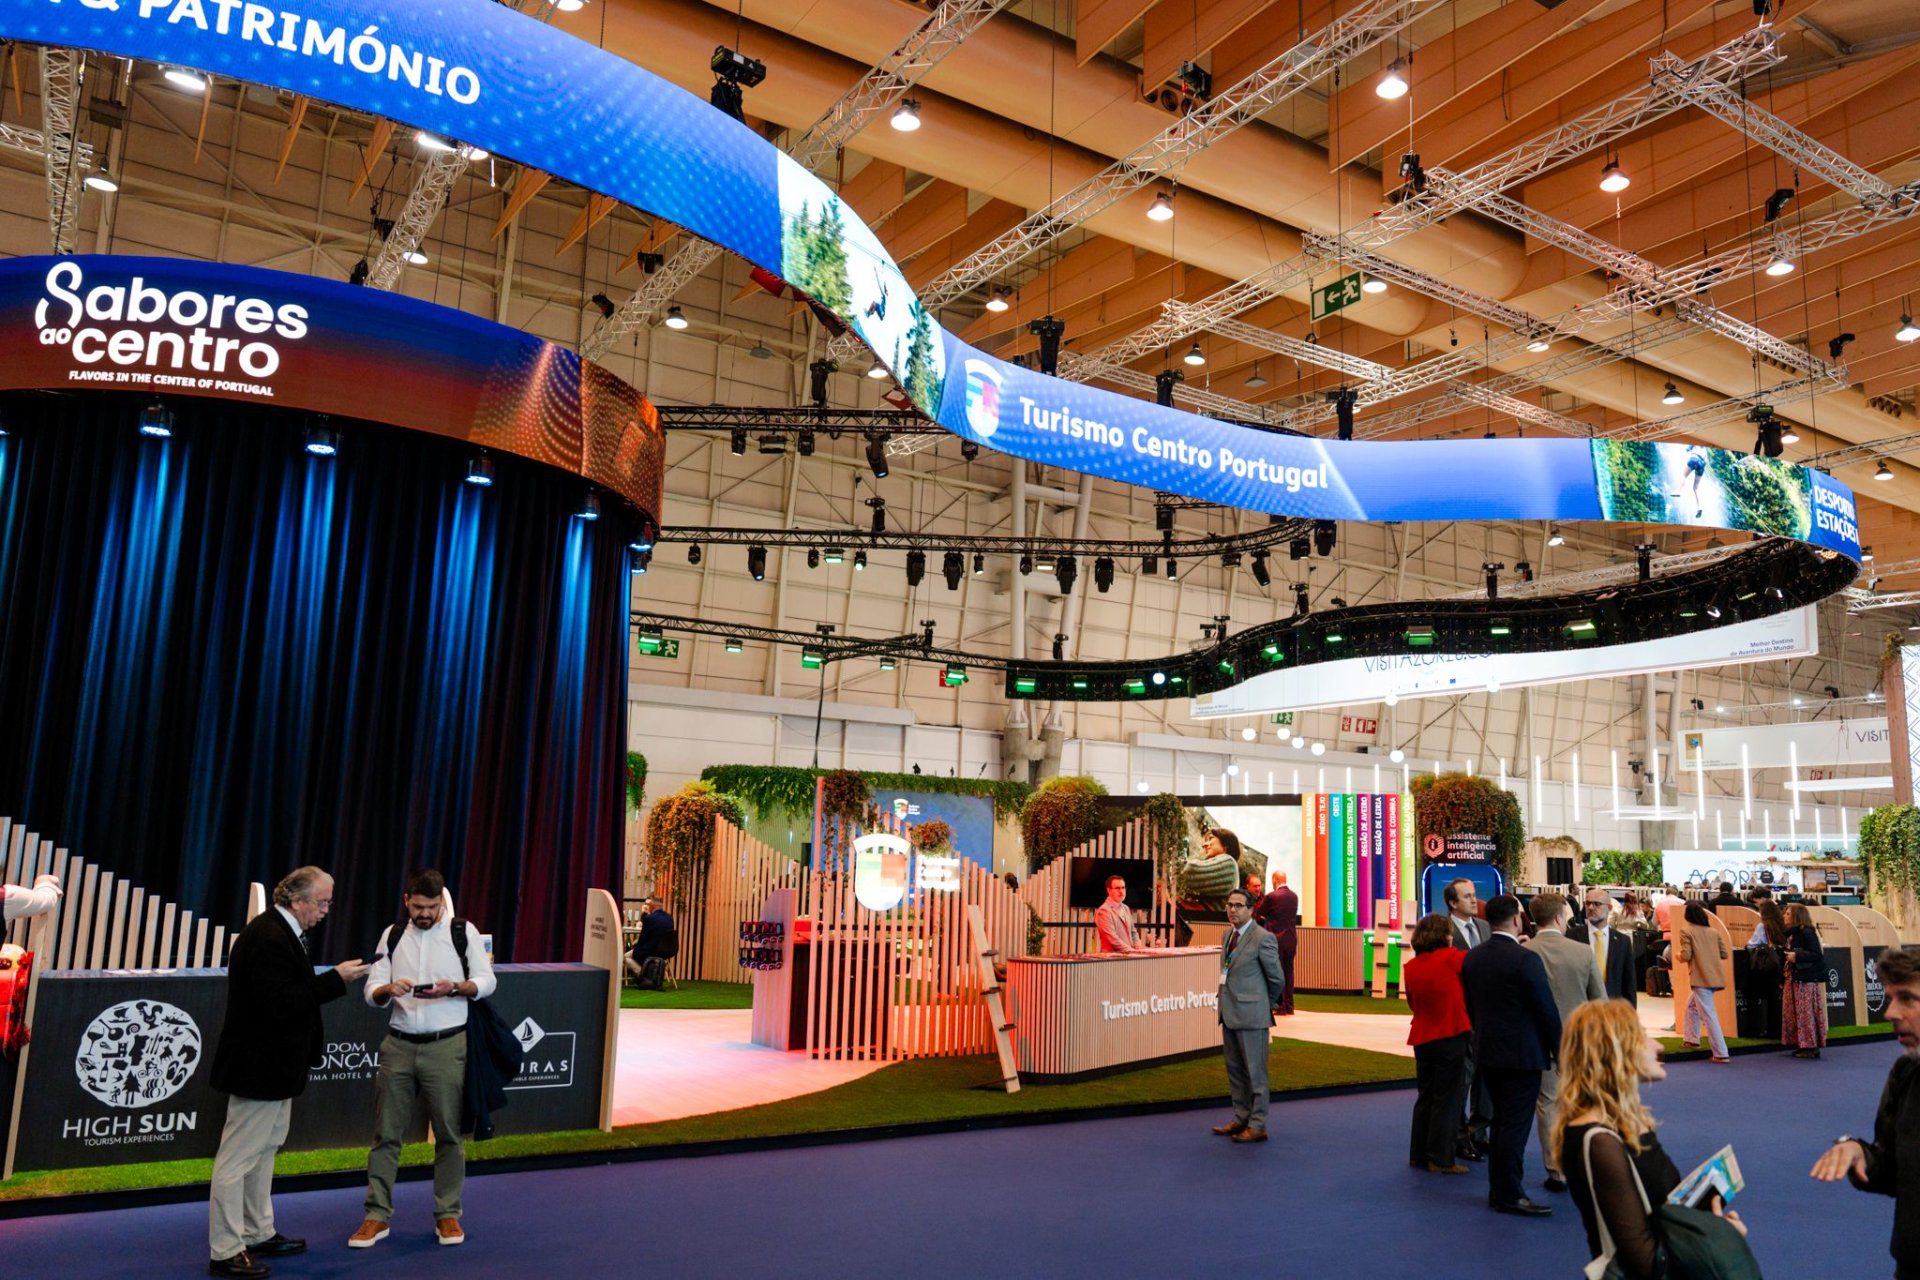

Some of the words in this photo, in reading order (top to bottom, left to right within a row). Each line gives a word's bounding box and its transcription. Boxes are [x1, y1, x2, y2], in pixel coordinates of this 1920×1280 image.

[139, 0, 481, 105] PATRIMÓNIO
[34, 261, 309, 340] Sabores
[39, 327, 72, 345] ao
[72, 327, 280, 378] centro
[69, 370, 115, 382] FLAVORS
[116, 373, 130, 383] IN
[131, 373, 152, 384] THE
[153, 374, 196, 388] CENTER
[198, 378, 214, 390] OF
[215, 380, 274, 397] PORTUGAL
[1019, 396, 1125, 448] Turismo
[1132, 428, 1213, 469] Centro
[1219, 448, 1328, 492] Portugal
[1347, 825, 1354, 834] DA
[1361, 822, 1368, 831] DE
[1375, 820, 1382, 829] DE
[1390, 828, 1397, 837] DE
[1360, 832, 1368, 857] REGIÃO
[1374, 830, 1382, 855] REGIÃO
[1447, 841, 1497, 851] inteligência
[1447, 851, 1485, 860] artificial
[1346, 887, 1354, 913] REGIÃO
[1388, 894, 1397, 920] REGIÃO
[1102, 997, 1148, 1020] Turismo
[1150, 993, 1185, 1013] Centro
[1187, 990, 1219, 1010] Portug
[326, 1042, 366, 1053] DOM
[310, 1052, 381, 1071] ONÇAL
[331, 1071, 361, 1080] HOTEL
[365, 1071, 372, 1079] &
[63, 1115, 132, 1139] HIGH
[138, 1111, 198, 1134] SUN
[84, 1136, 122, 1147] TOURISM
[123, 1133, 175, 1145] EXPERIENCES
